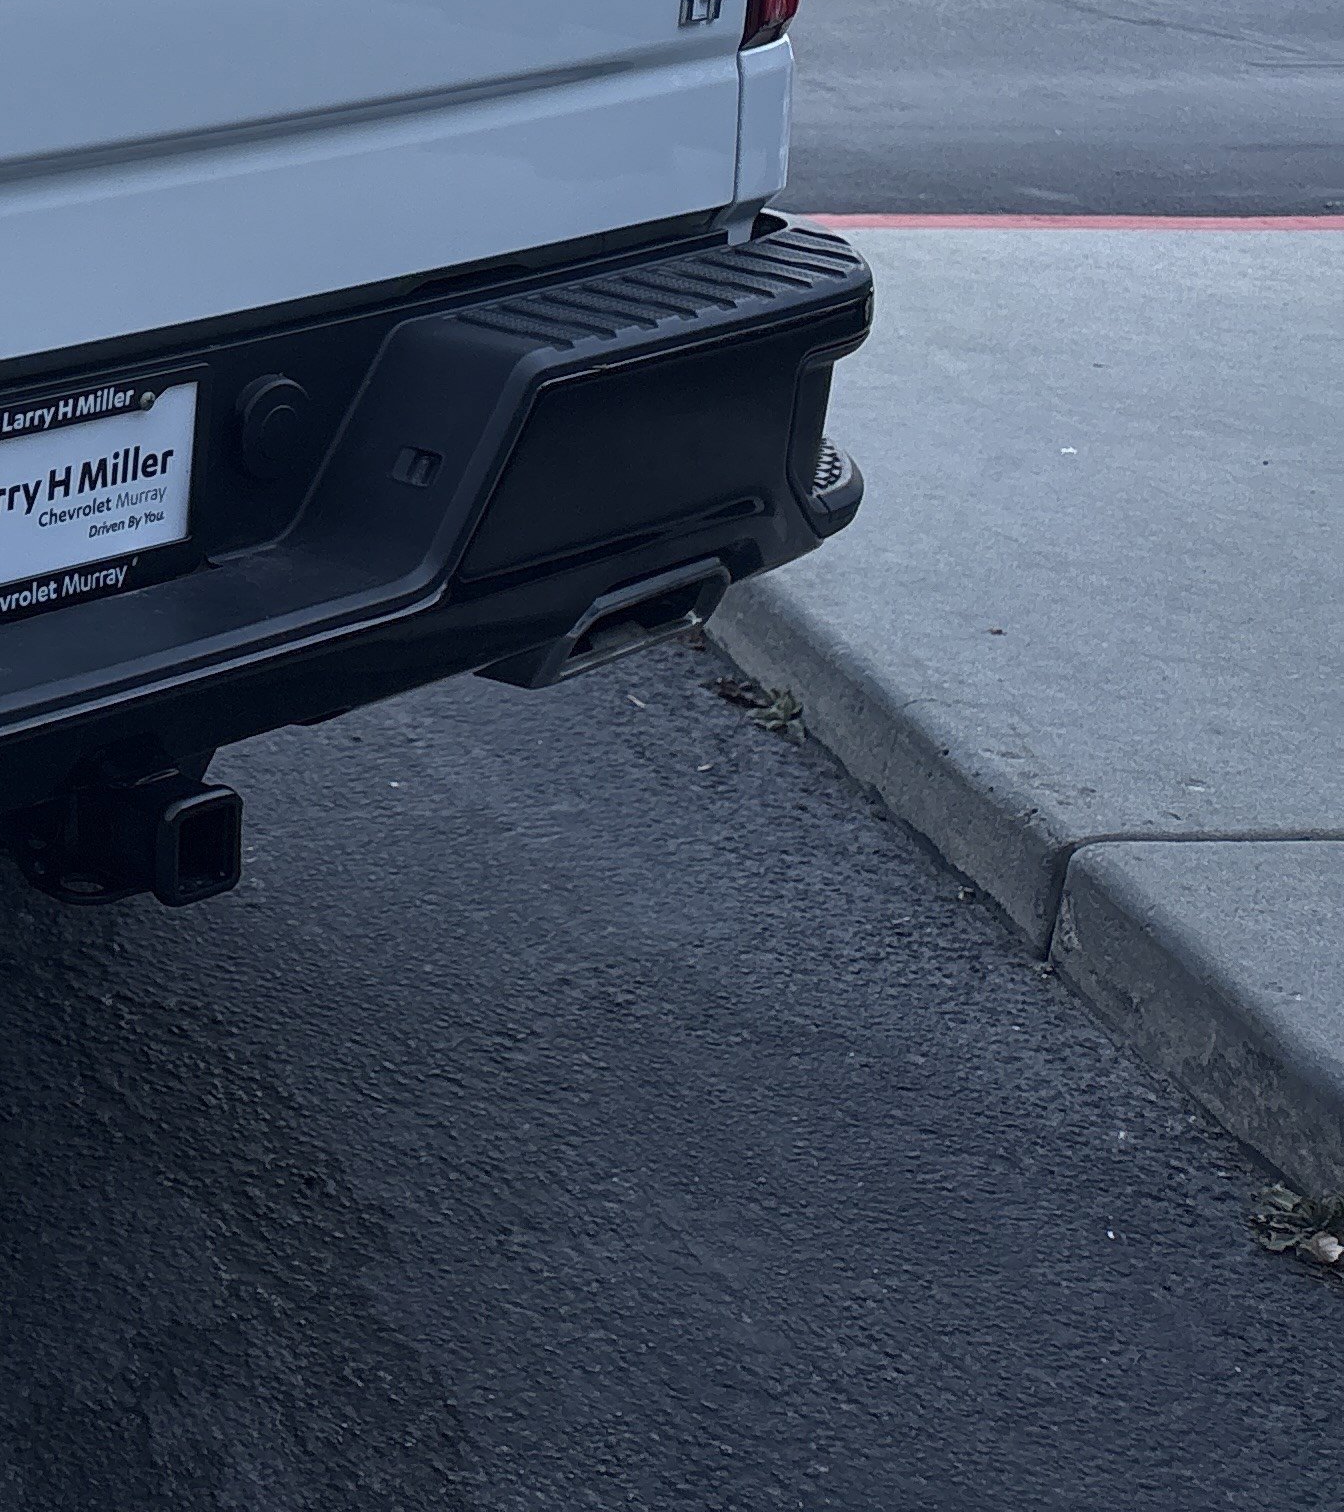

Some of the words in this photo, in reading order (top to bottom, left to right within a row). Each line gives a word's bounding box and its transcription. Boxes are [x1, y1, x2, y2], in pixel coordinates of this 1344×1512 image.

[2, 406, 55, 433] Larry
[58, 398, 73, 421] H
[76, 387, 135, 417] Miller
[48, 465, 71, 501] H
[77, 445, 174, 495] Miller
[38, 495, 112, 528] Chevrolet
[116, 486, 168, 510] Murray
[88, 518, 125, 539] Driven
[127, 514, 143, 531] By
[62, 563, 128, 598] Murray
